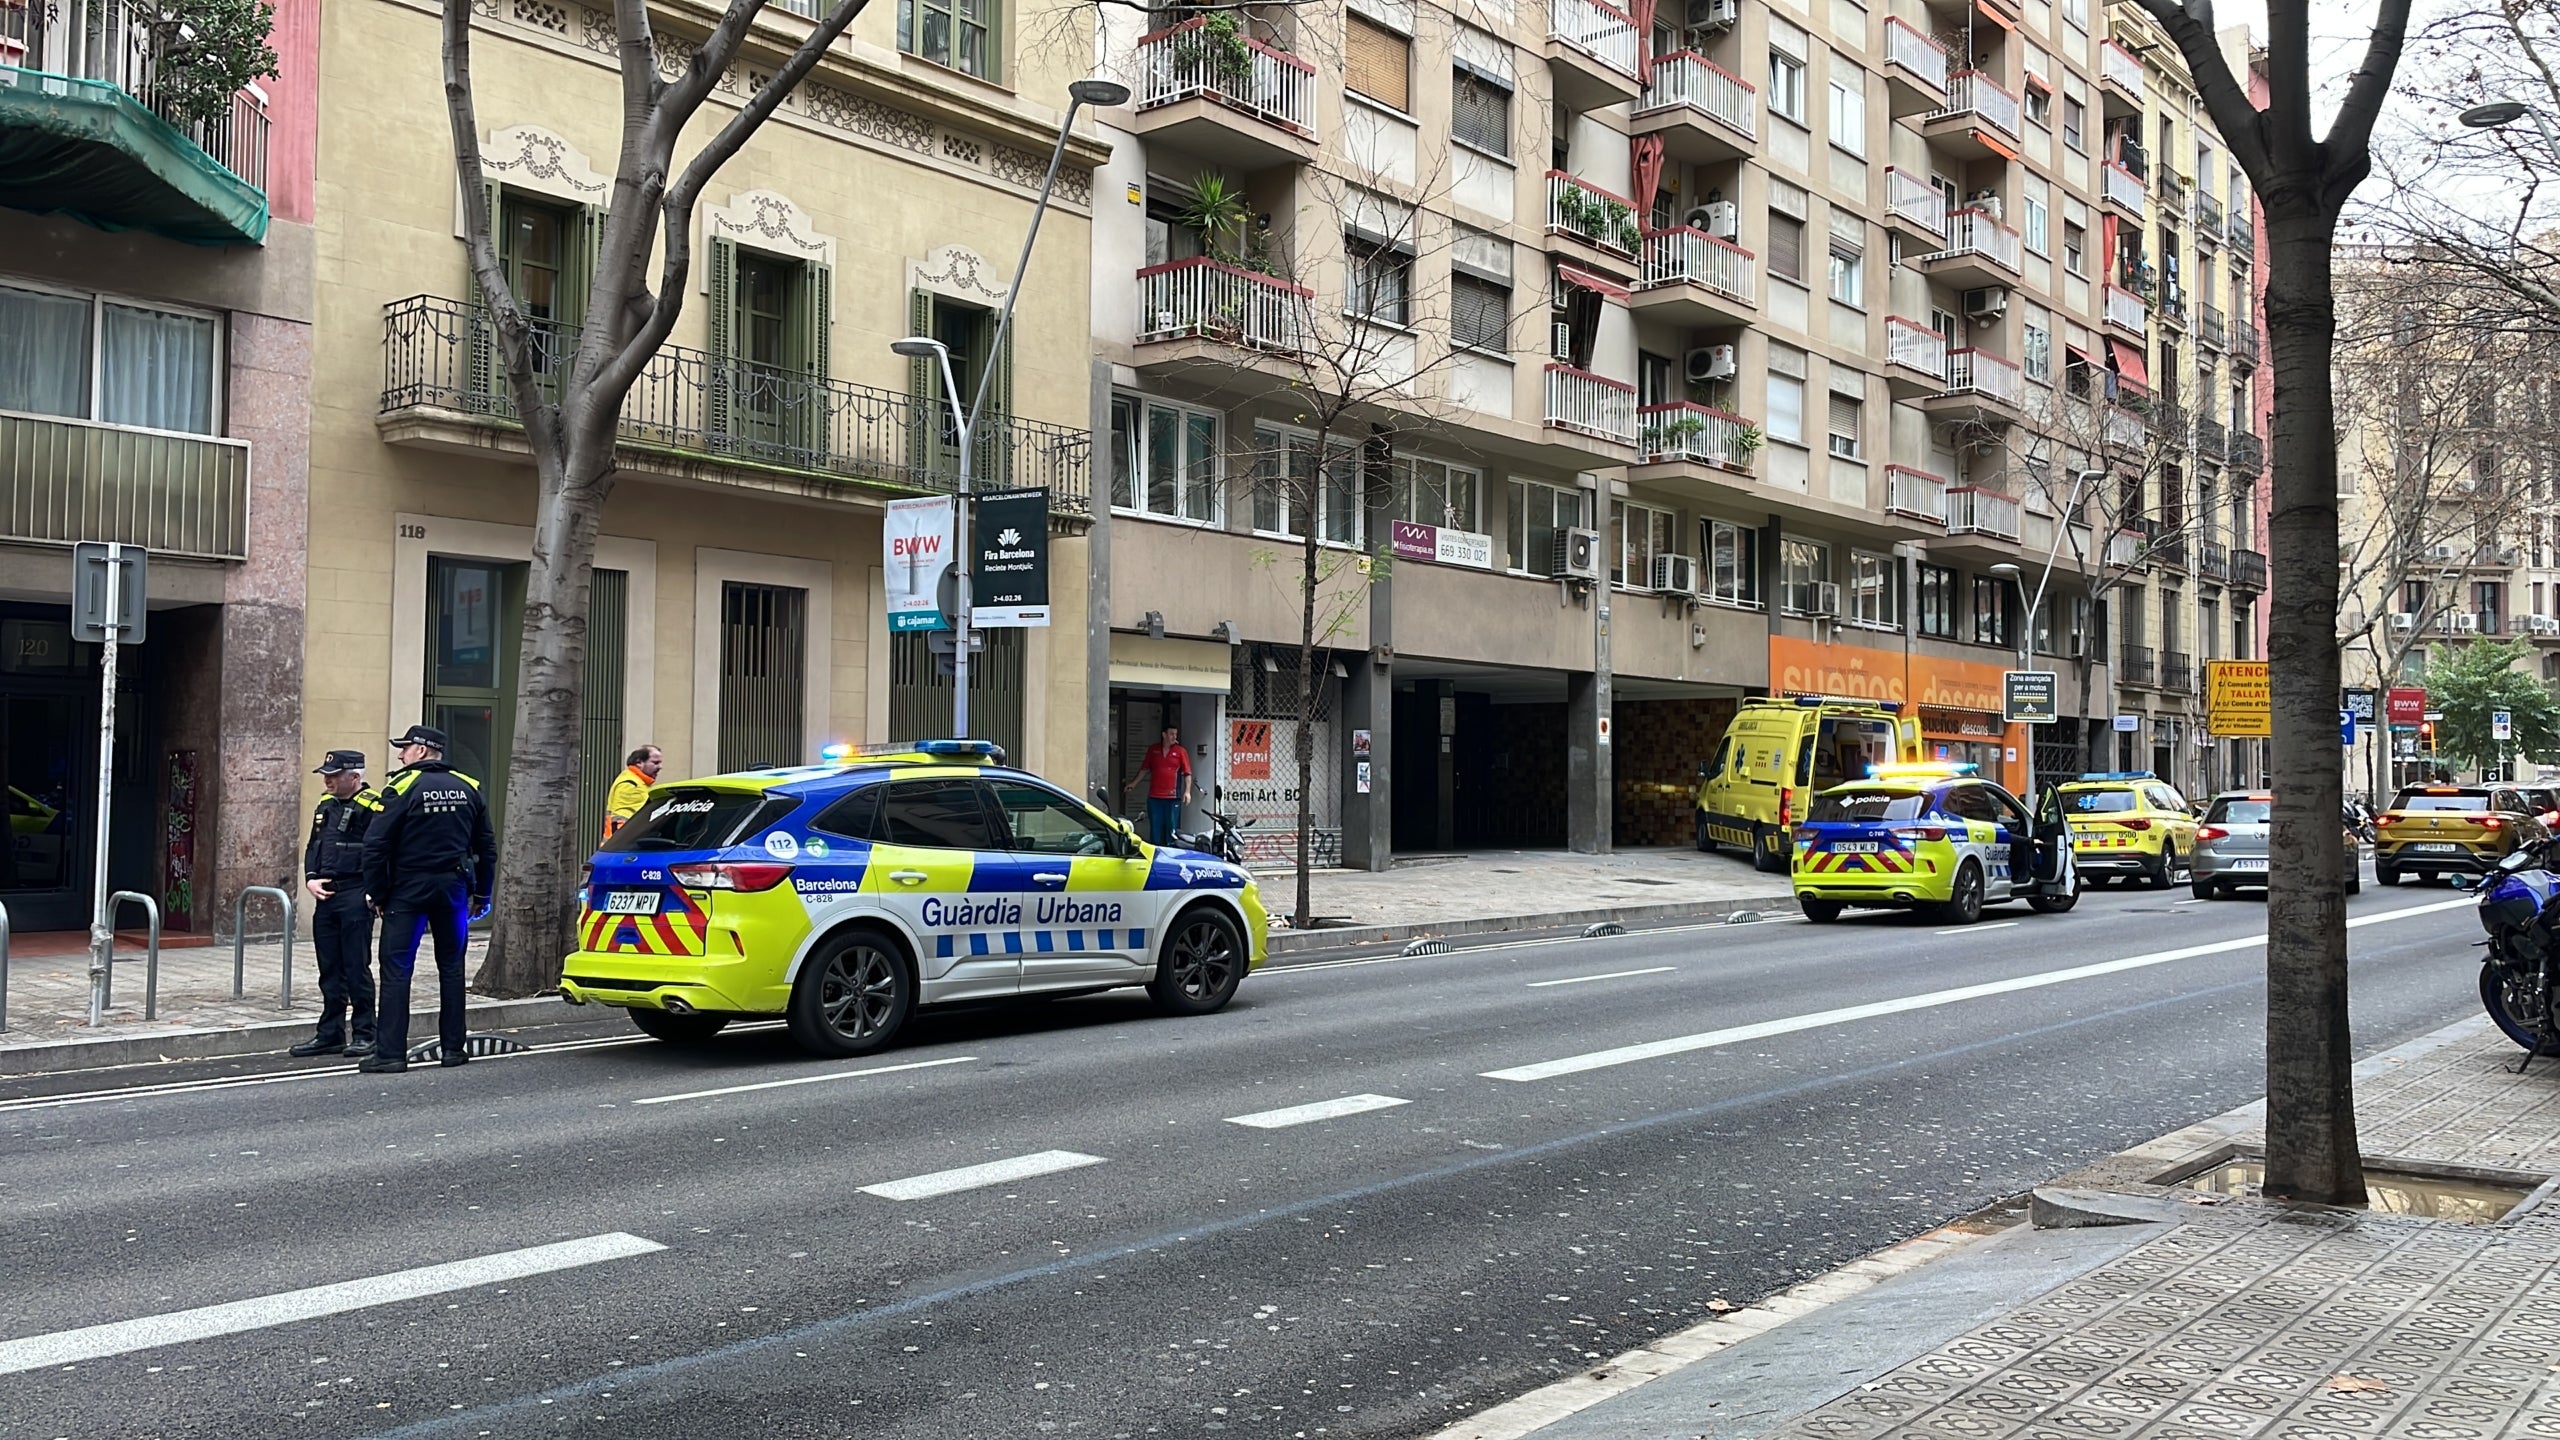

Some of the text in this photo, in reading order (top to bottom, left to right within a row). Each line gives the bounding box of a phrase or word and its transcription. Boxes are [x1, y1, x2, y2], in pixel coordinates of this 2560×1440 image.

[982, 491, 1042, 501] #BARCELONAWINEWEEK
[400, 524, 426, 539] 118
[893, 535, 942, 556] BWW
[984, 549, 1035, 560] Fira Barcelona
[1441, 544, 1487, 562] 669 330 021
[985, 564, 1007, 572] Recinte
[906, 616, 936, 627] cajamar
[18, 639, 48, 656] 120
[2218, 666, 2269, 677] ATENCI
[2009, 674, 2051, 683] Zona avançada
[1923, 674, 2003, 711] descan
[2014, 684, 2024, 692] per
[2029, 684, 2047, 692] motos
[2231, 690, 2266, 698] TALLAT
[2394, 700, 2420, 708] BWW
[1961, 720, 1989, 737] descans
[1232, 750, 1268, 765] gremi
[422, 790, 467, 800] POLICIA
[1257, 789, 1277, 802] Art
[1855, 795, 1891, 805] policia
[665, 799, 715, 815] policia
[770, 839, 793, 850] 112
[1836, 842, 1876, 851] 0543 MLR
[1984, 846, 2010, 861] Guàrdia
[641, 870, 662, 880] C-828
[1195, 867, 1223, 879] policia
[796, 878, 858, 891] Barcelona
[609, 895, 657, 911] 6237 MPV
[806, 894, 833, 903] C-828
[922, 897, 1122, 927] Guàrdia Urbana
